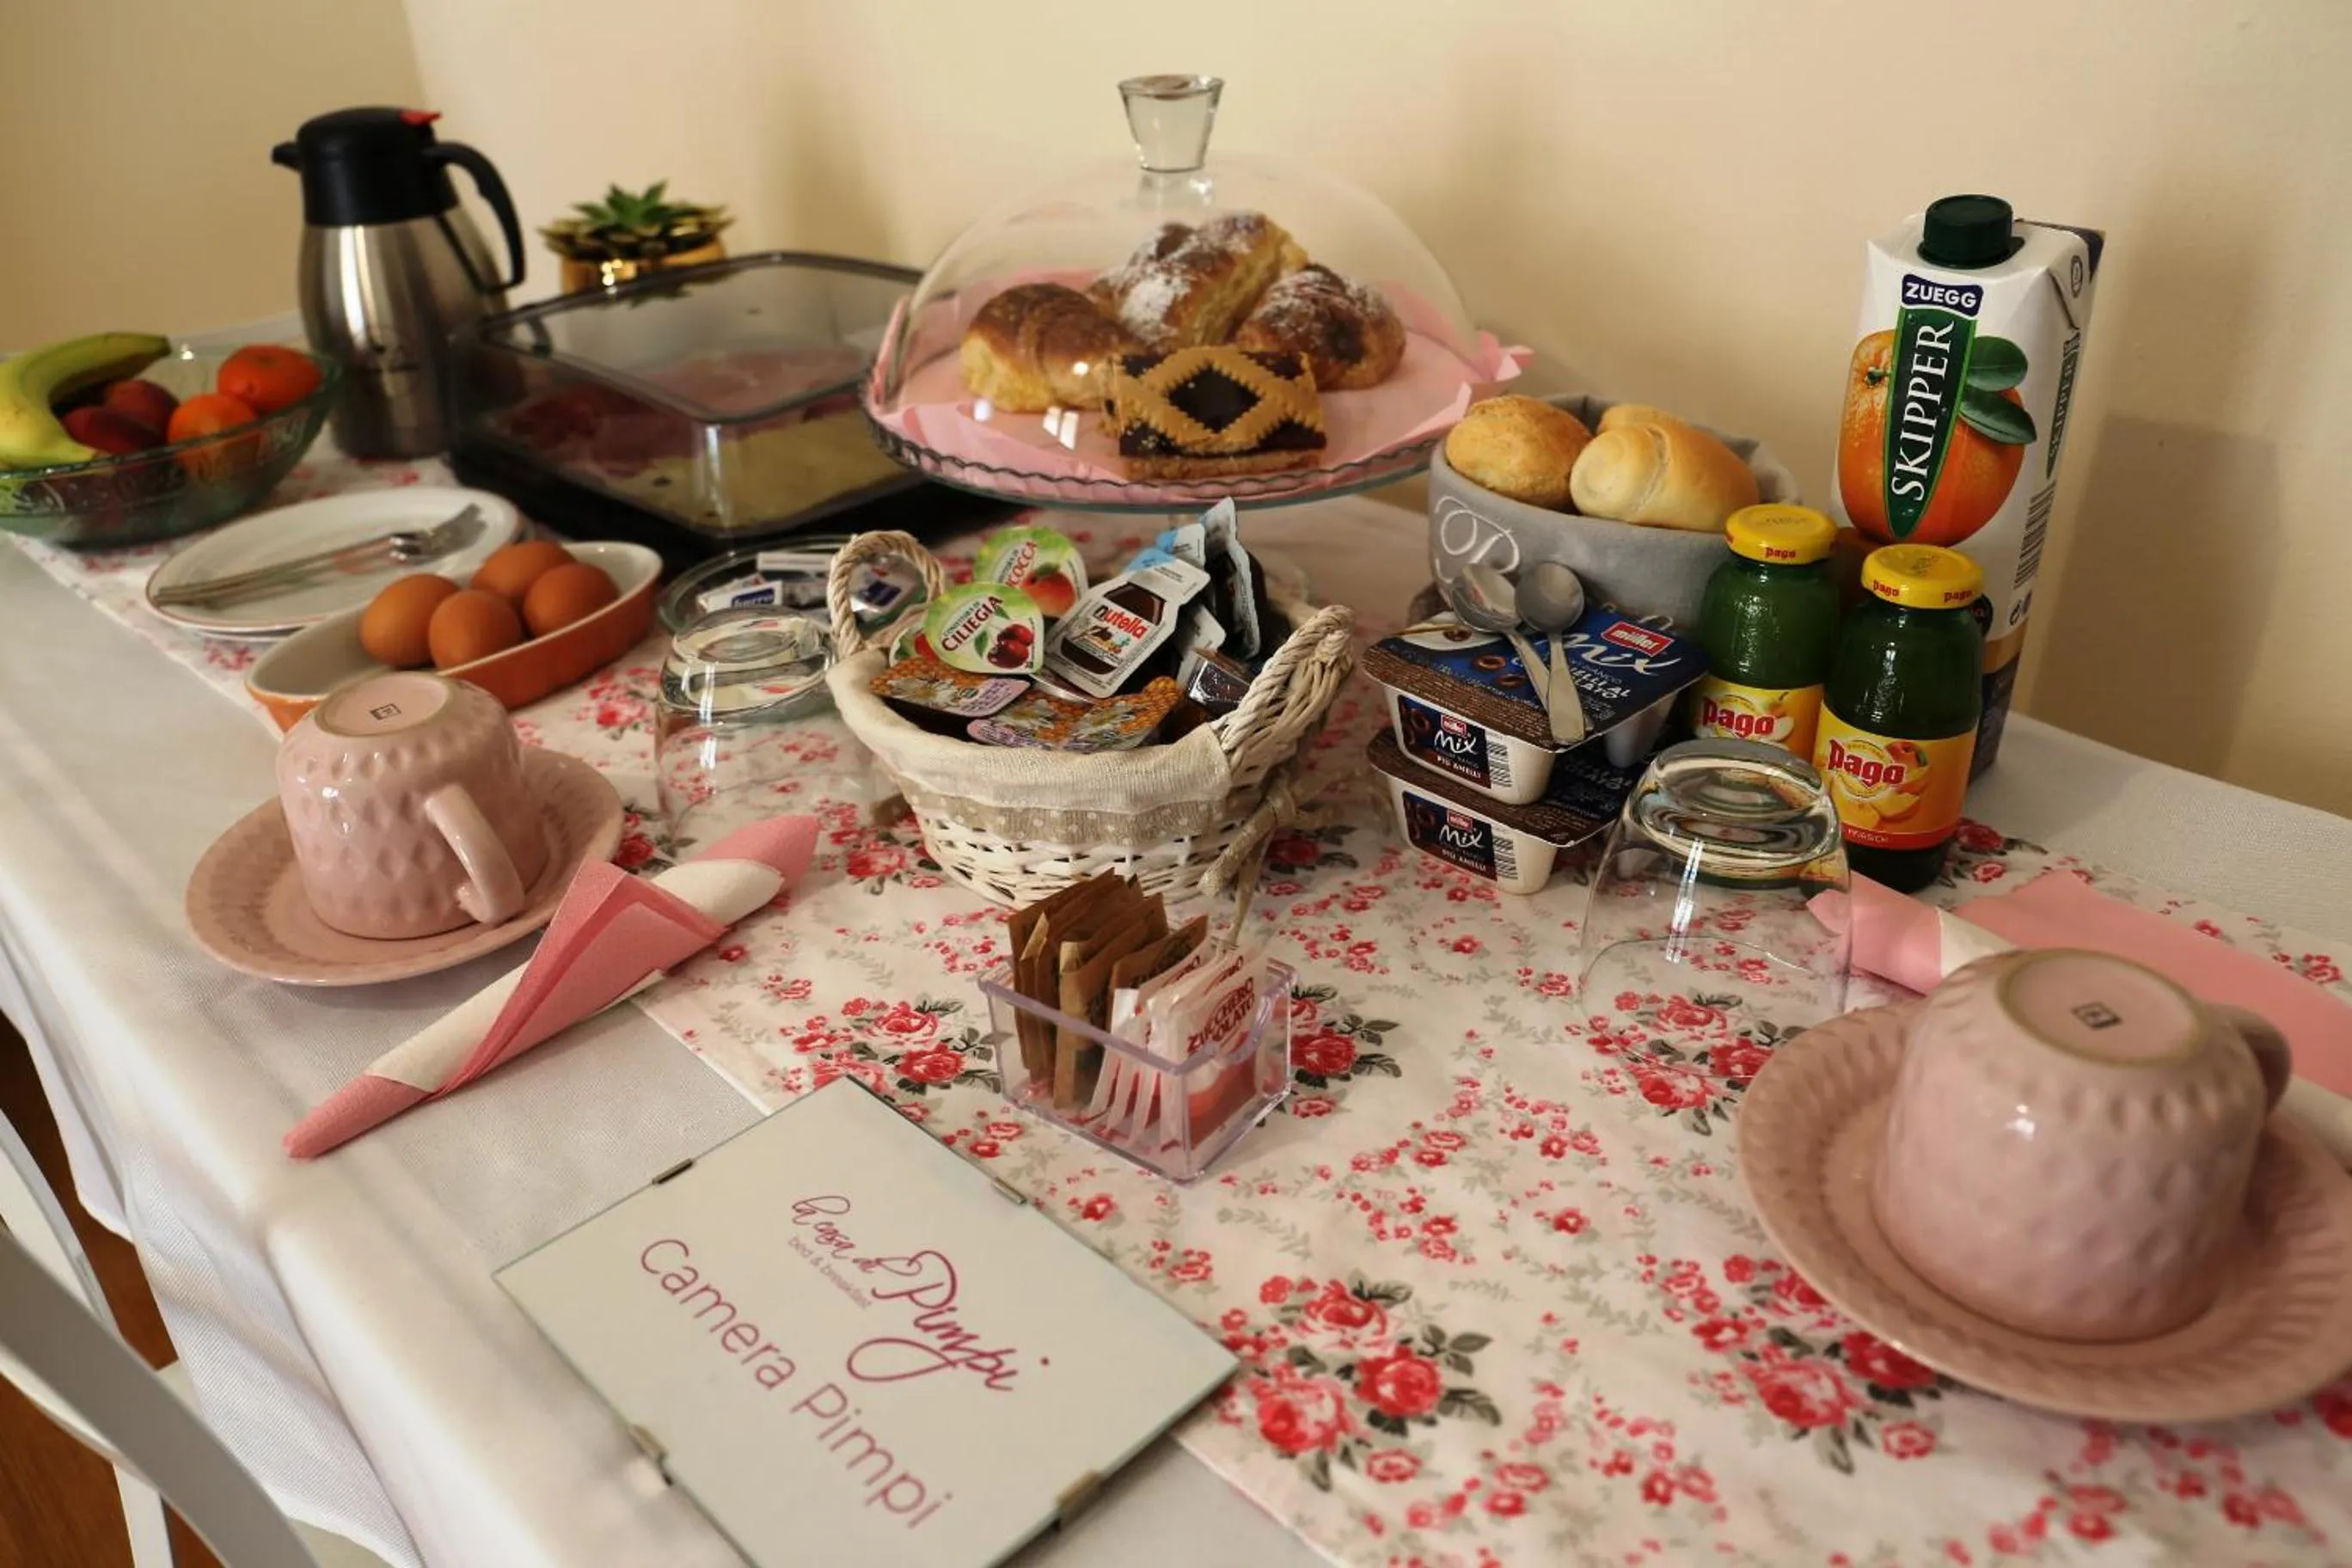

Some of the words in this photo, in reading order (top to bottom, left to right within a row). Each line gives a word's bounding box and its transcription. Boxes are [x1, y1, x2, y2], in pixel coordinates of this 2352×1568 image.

[1905, 281, 1976, 308] ZUEGG
[1891, 320, 1955, 501] SKIPPER
[1766, 547, 1796, 559] pago
[1873, 580, 1900, 597] pago
[1944, 590, 1973, 603] pago
[941, 596, 1004, 652] CILIEGIA
[1093, 605, 1148, 640] nutella
[1610, 628, 1661, 651] müller
[1703, 697, 1775, 738] pago
[1828, 739, 1906, 788] pago
[847, 1250, 1050, 1392] Pimpi
[640, 1238, 797, 1391] Camera
[789, 1382, 953, 1530] Pimpi
